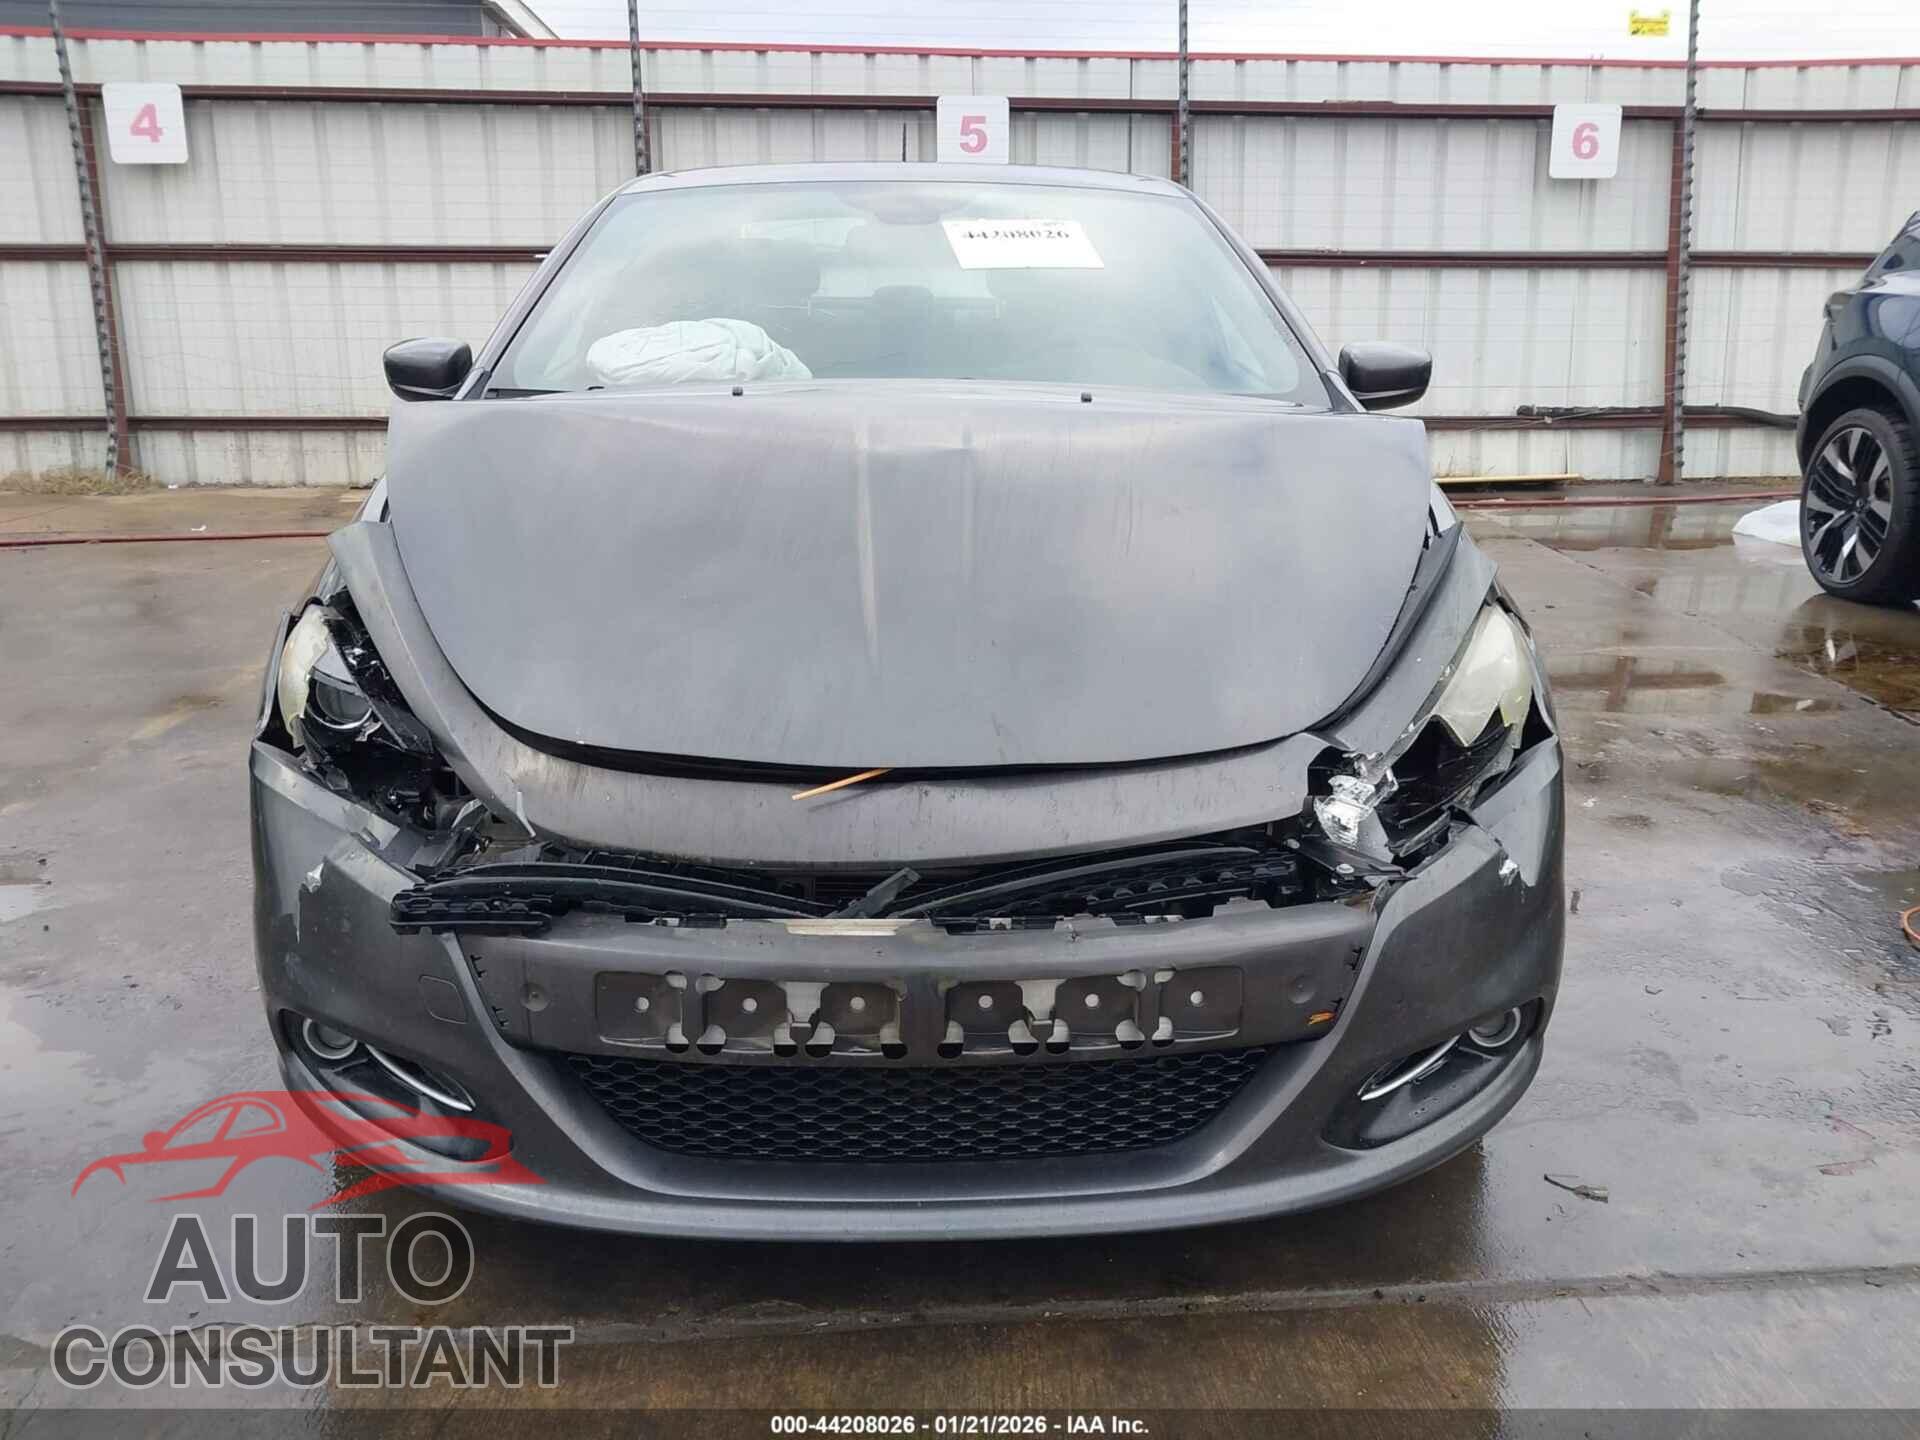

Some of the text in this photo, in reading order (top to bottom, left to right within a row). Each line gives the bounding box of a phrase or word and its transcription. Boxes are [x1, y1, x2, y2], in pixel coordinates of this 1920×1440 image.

[130, 104, 163, 143] 4
[959, 115, 988, 153] 5
[1571, 122, 1599, 160] 6
